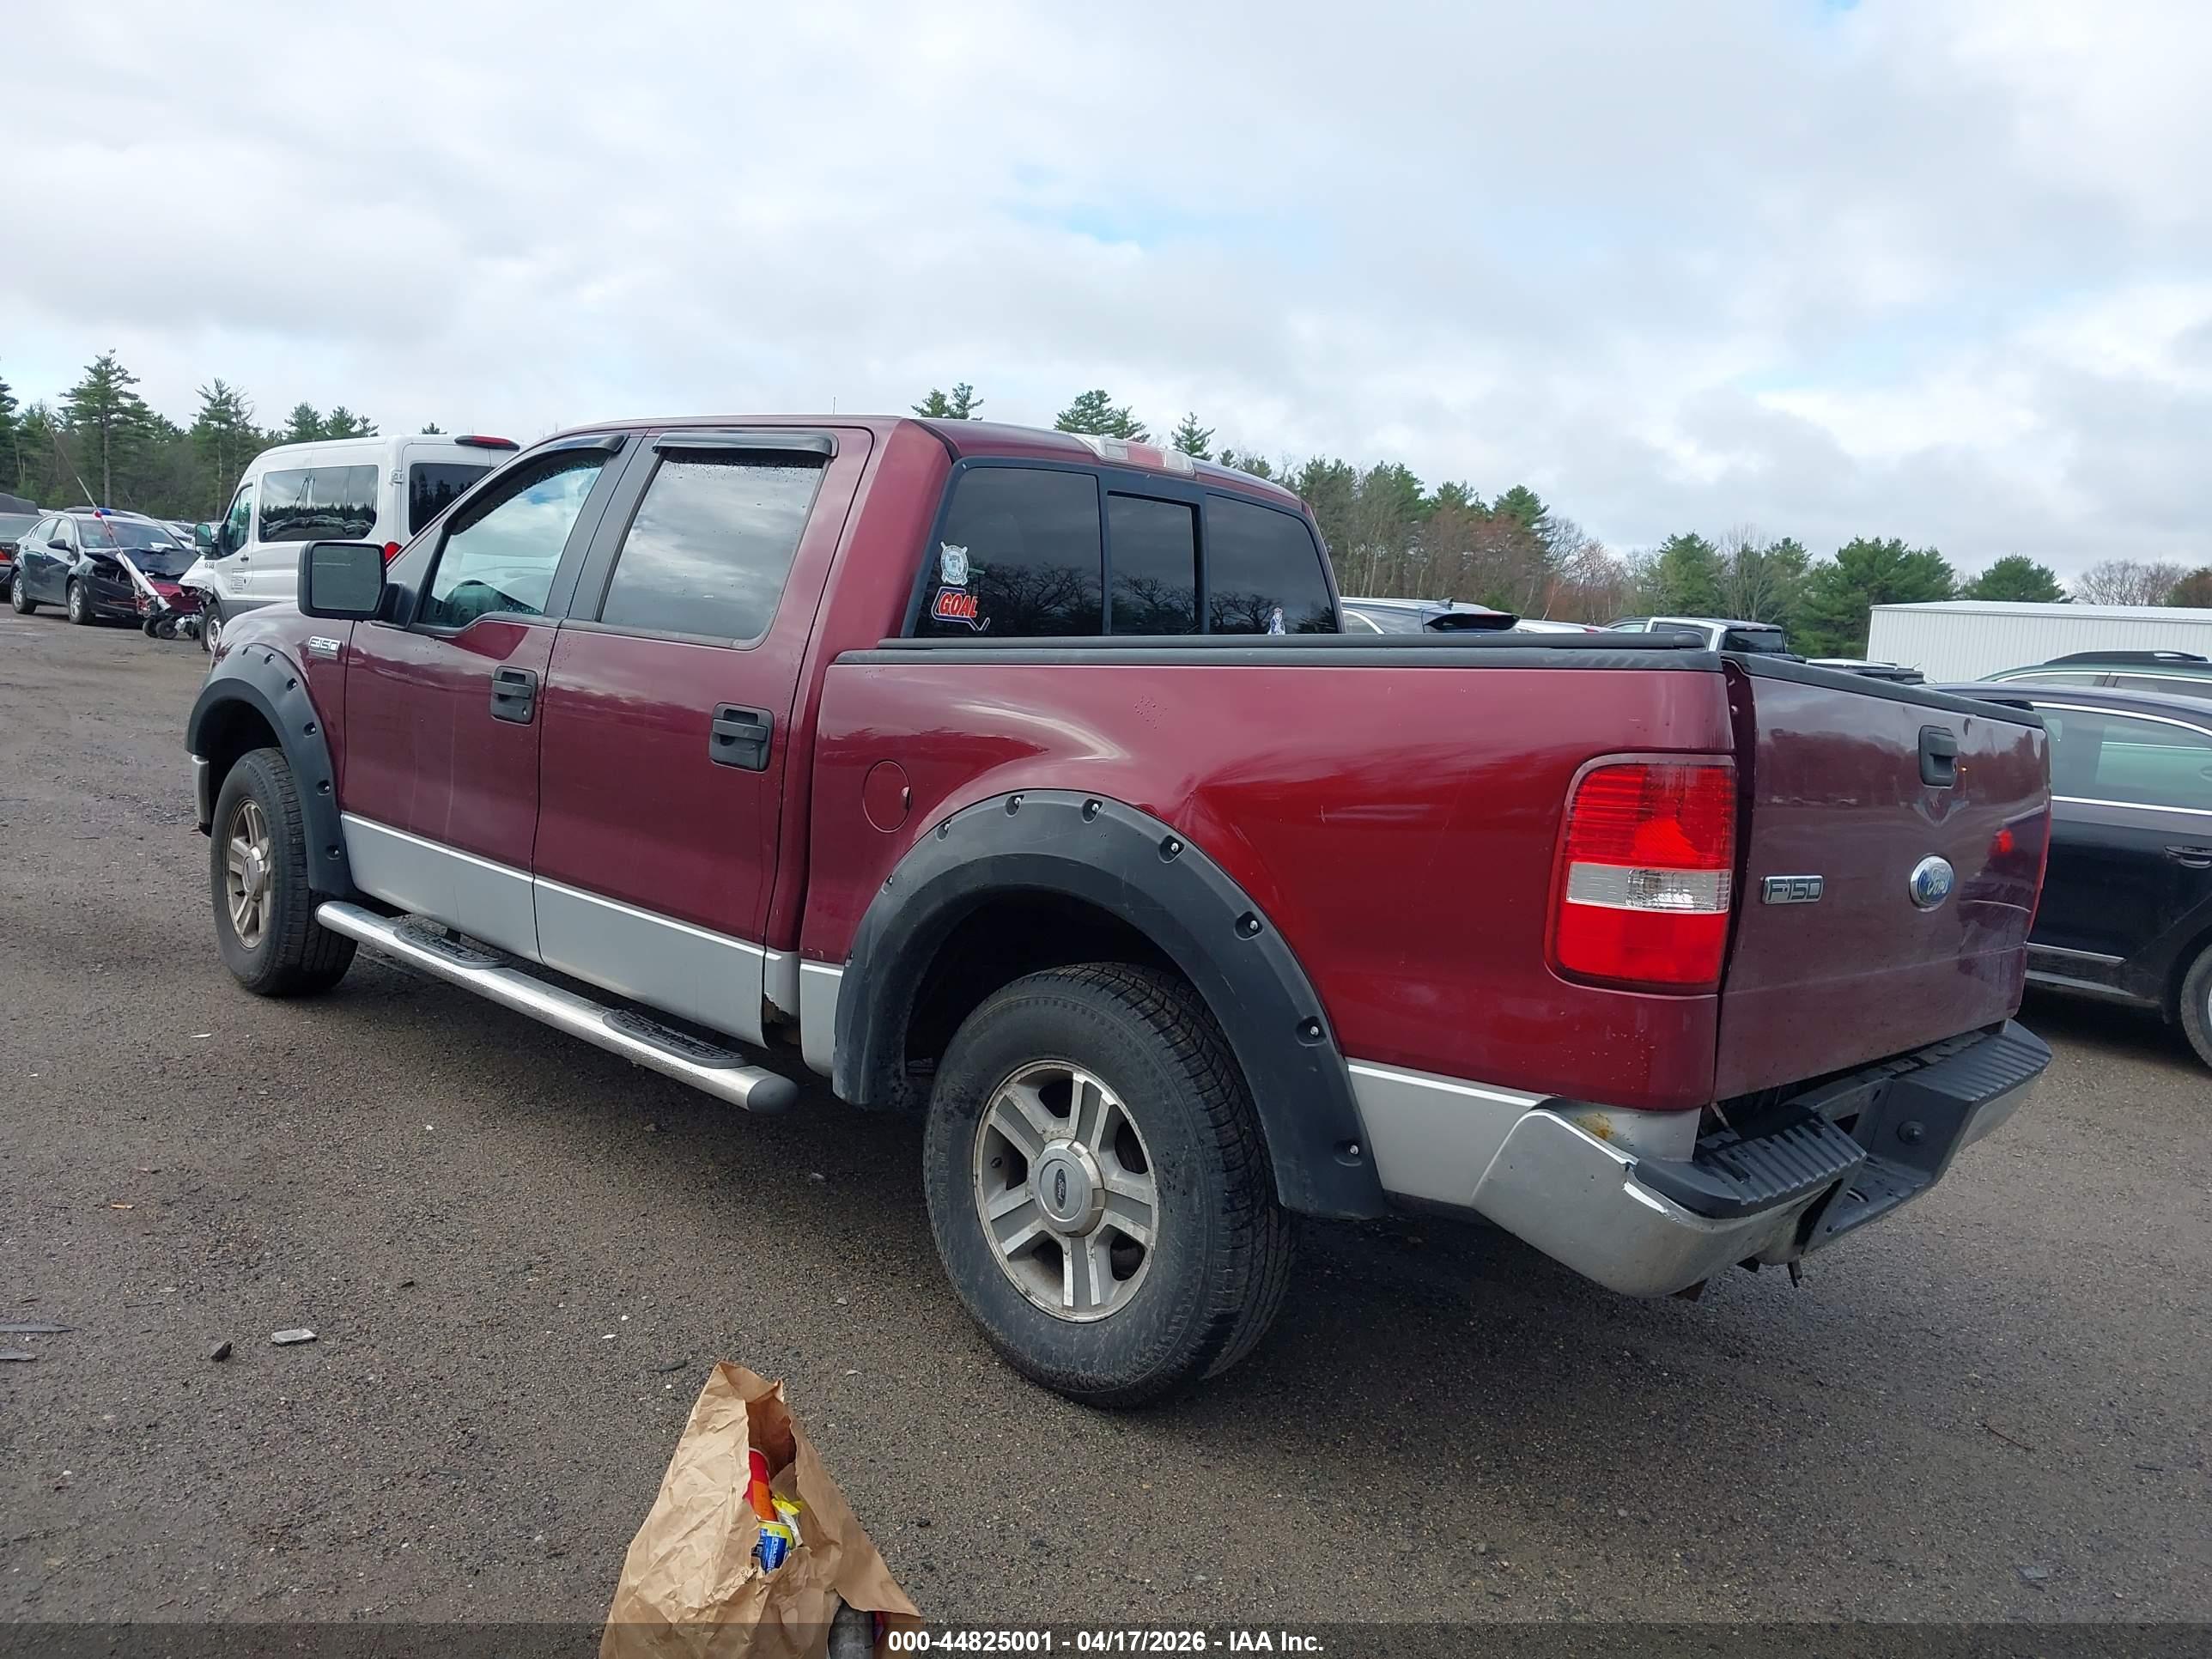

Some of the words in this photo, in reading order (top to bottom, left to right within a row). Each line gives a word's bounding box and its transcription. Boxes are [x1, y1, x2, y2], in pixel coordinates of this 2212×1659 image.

[939, 592, 979, 617] GOAL
[1926, 866, 1950, 896] Ford
[770, 1537, 779, 1568] RECYCLE
